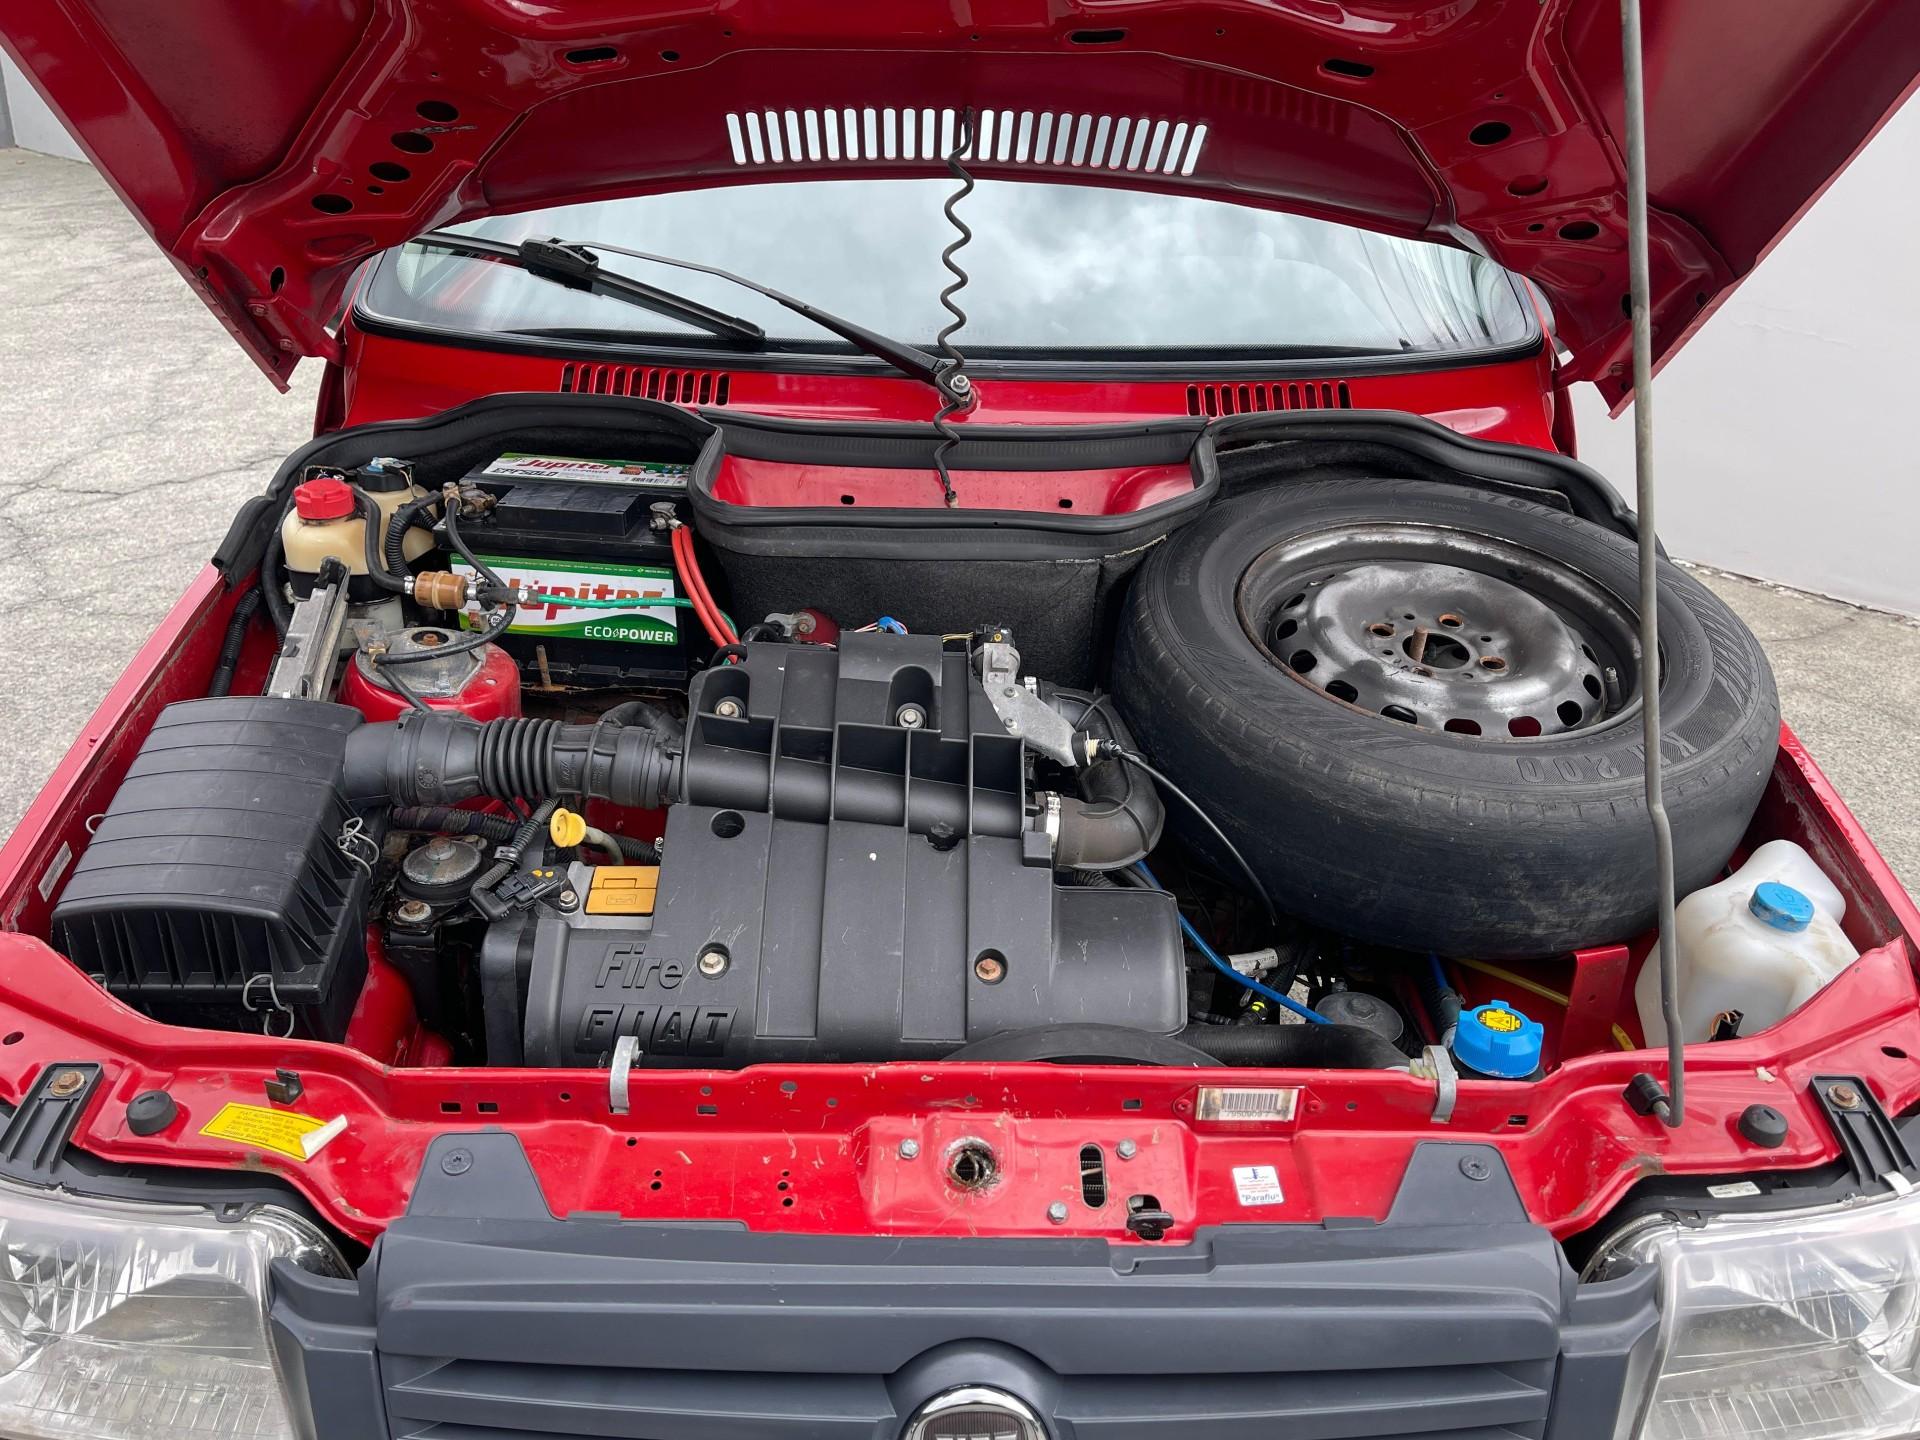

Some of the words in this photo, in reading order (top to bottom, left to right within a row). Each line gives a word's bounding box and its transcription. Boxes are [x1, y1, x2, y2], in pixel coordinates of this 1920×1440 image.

[517, 459, 613, 470] Jupiter
[584, 626, 612, 638] ECO
[619, 628, 674, 642] POWER
[595, 943, 685, 990] Fire
[581, 1008, 732, 1046] FIAT
